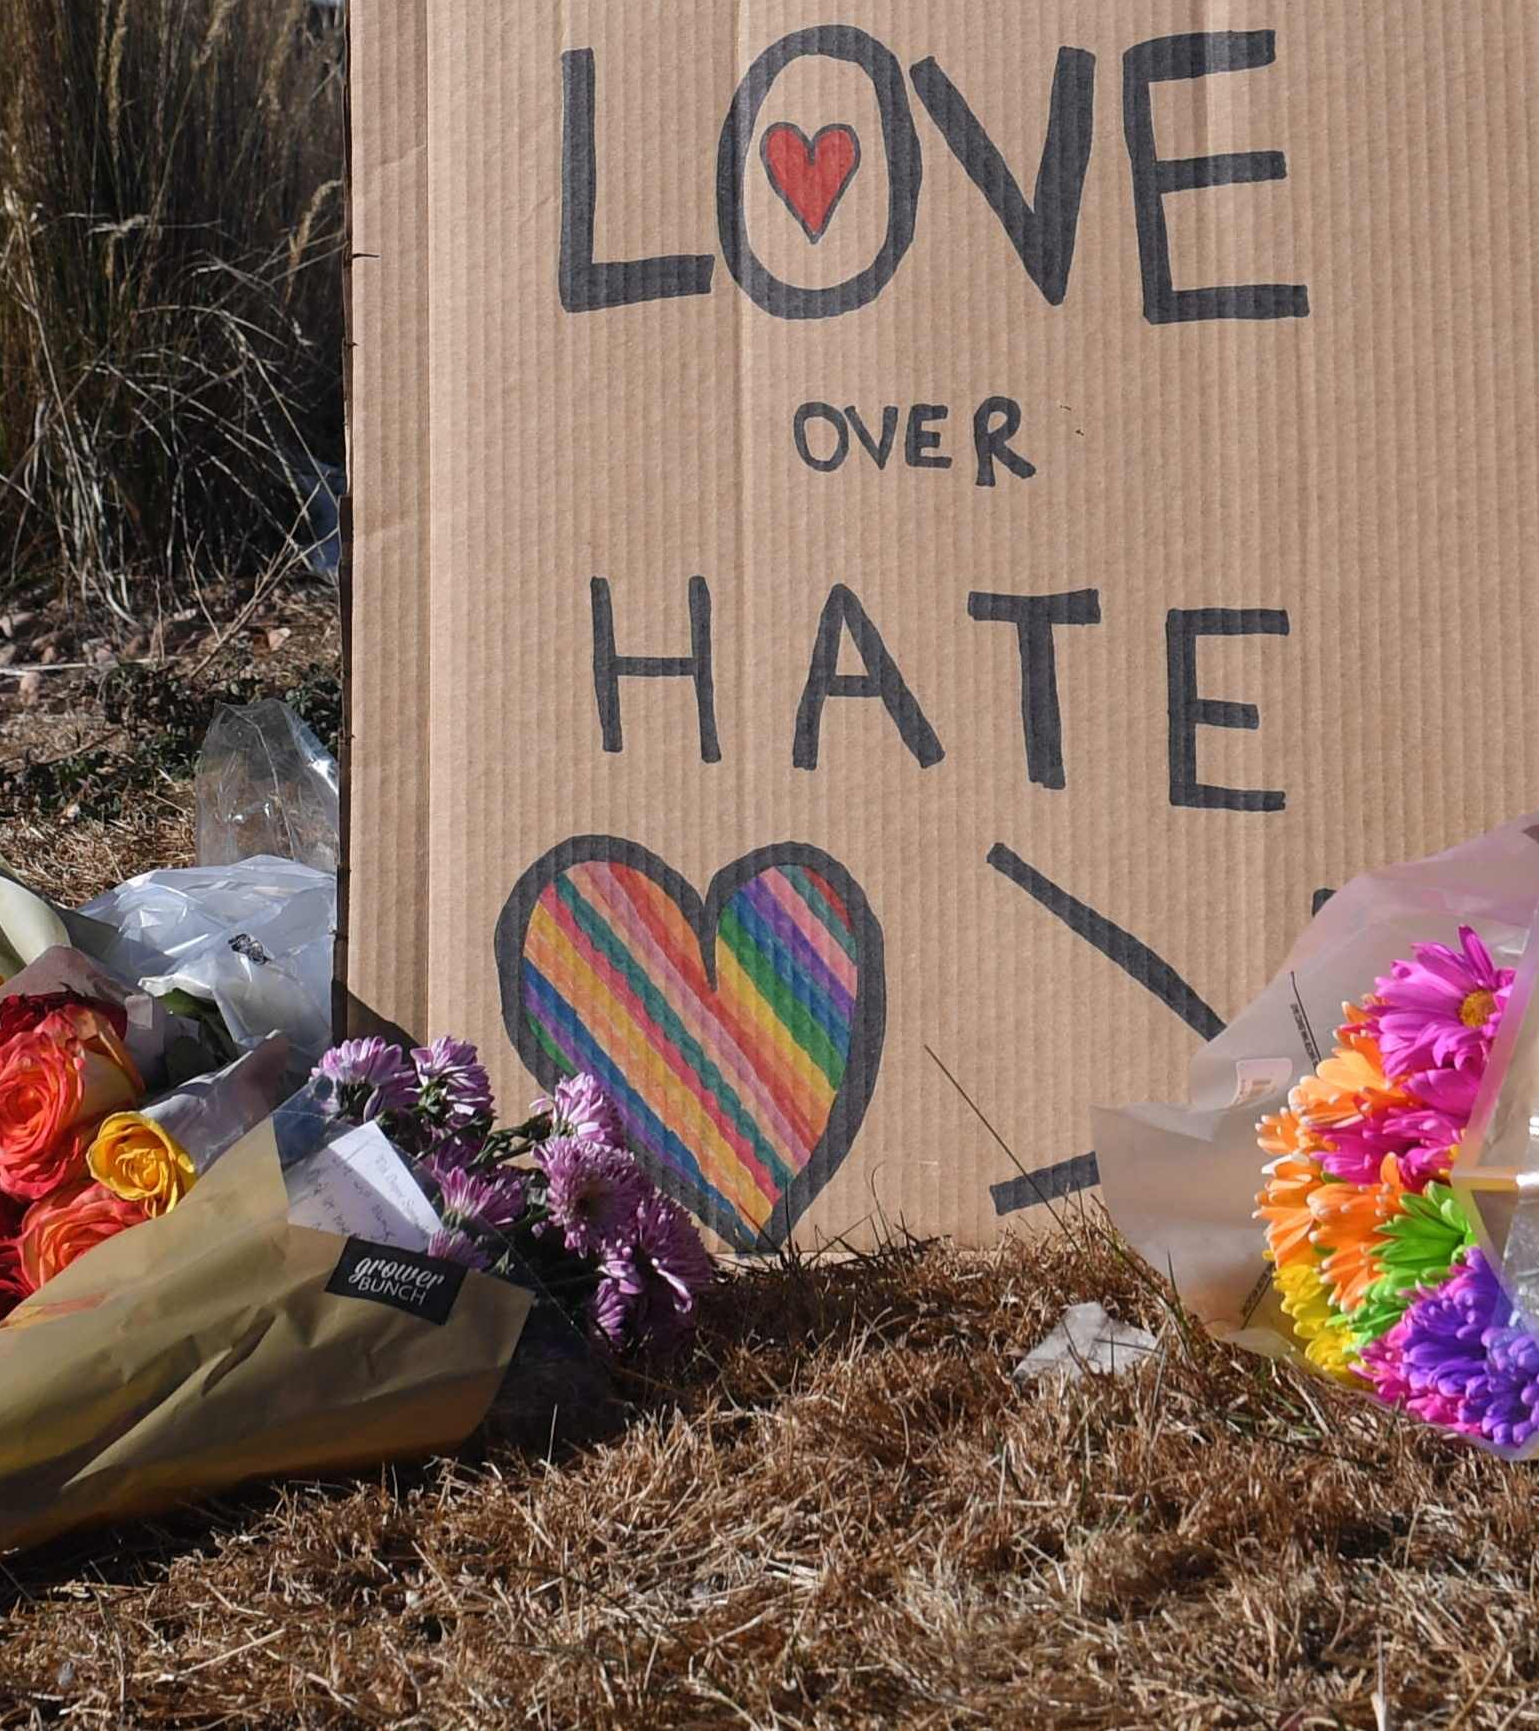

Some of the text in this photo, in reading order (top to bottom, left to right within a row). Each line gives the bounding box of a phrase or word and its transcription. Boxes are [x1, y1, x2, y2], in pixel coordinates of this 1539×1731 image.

[559, 24, 1309, 326] LOVE
[793, 396, 1036, 487] OVER
[590, 576, 1290, 812] HATE
[348, 1257, 445, 1289] grower
[357, 1276, 427, 1307] BUNCH
